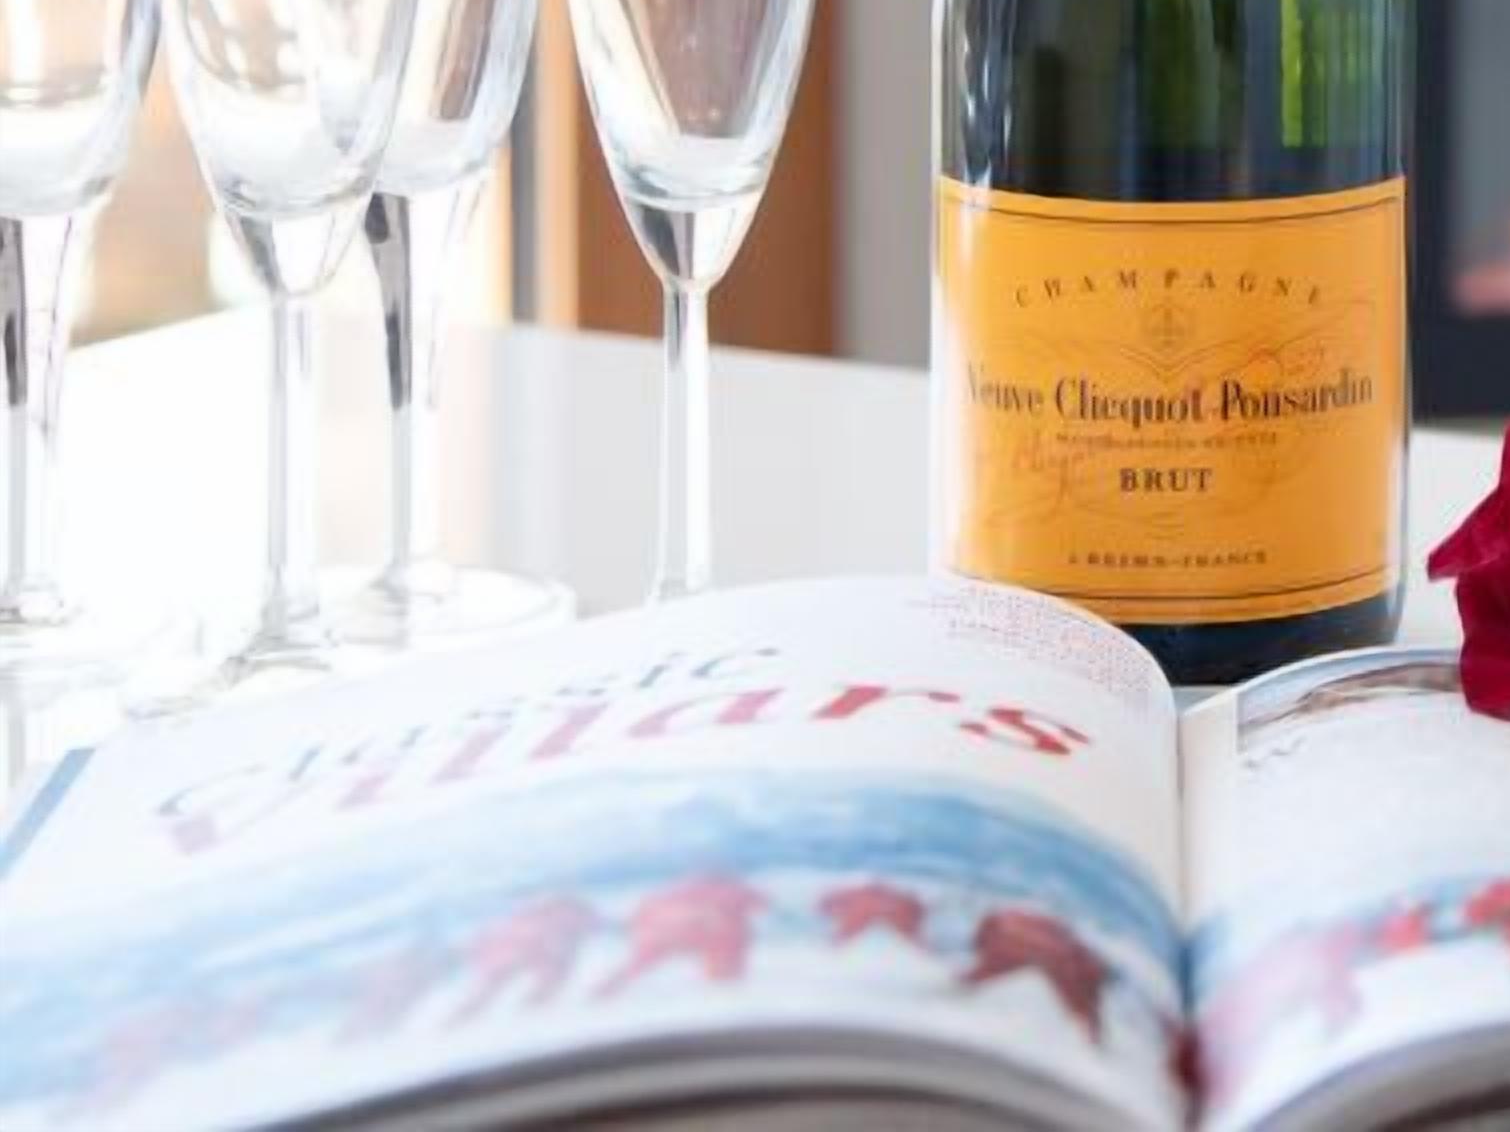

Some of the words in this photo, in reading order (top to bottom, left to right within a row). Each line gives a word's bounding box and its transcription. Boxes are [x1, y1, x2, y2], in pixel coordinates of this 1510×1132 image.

[1015, 268, 1323, 309] CHAMPAGNE
[1055, 374, 1203, 430] Clicquot
[1220, 367, 1374, 422] Ponsardin
[1119, 467, 1213, 493] BRUT
